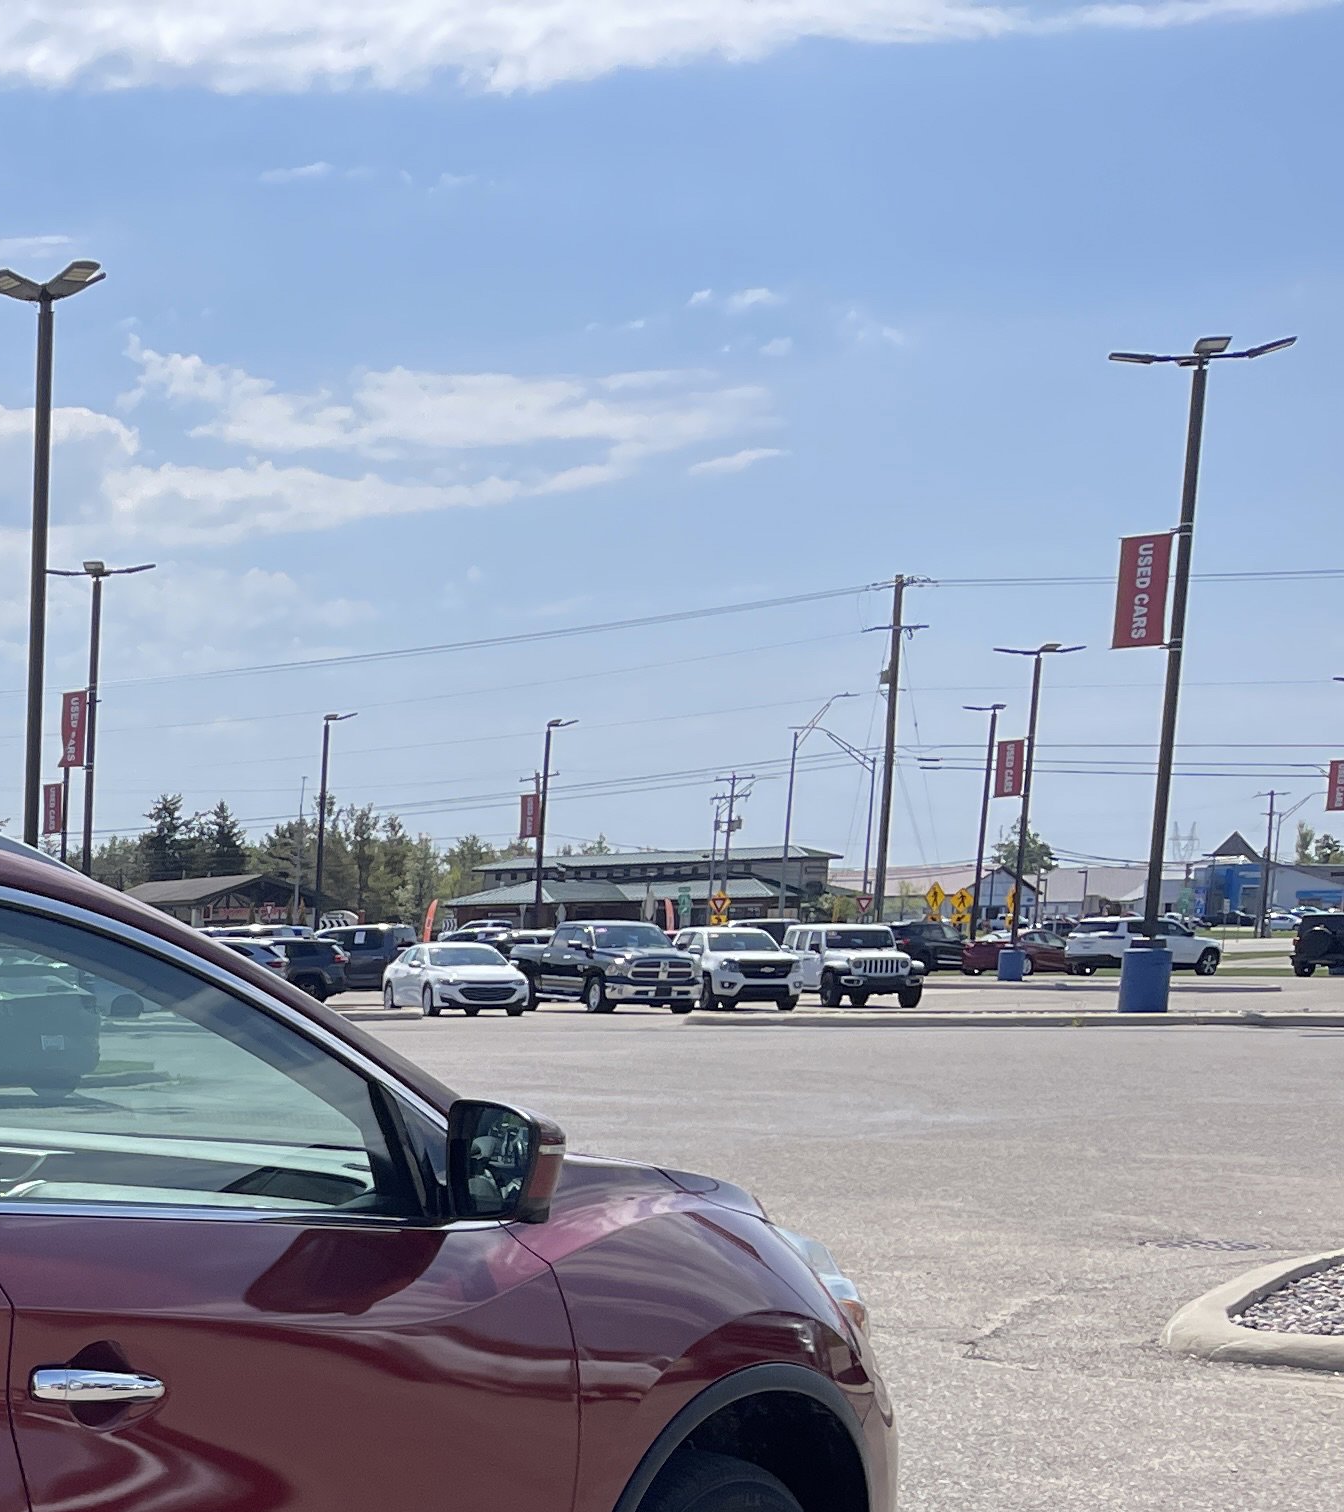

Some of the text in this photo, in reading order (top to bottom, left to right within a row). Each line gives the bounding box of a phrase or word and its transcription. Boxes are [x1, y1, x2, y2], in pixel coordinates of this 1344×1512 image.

[1131, 543, 1154, 639] USED CARS
[70, 697, 79, 728] USED
[1004, 743, 1015, 793] USED CARS
